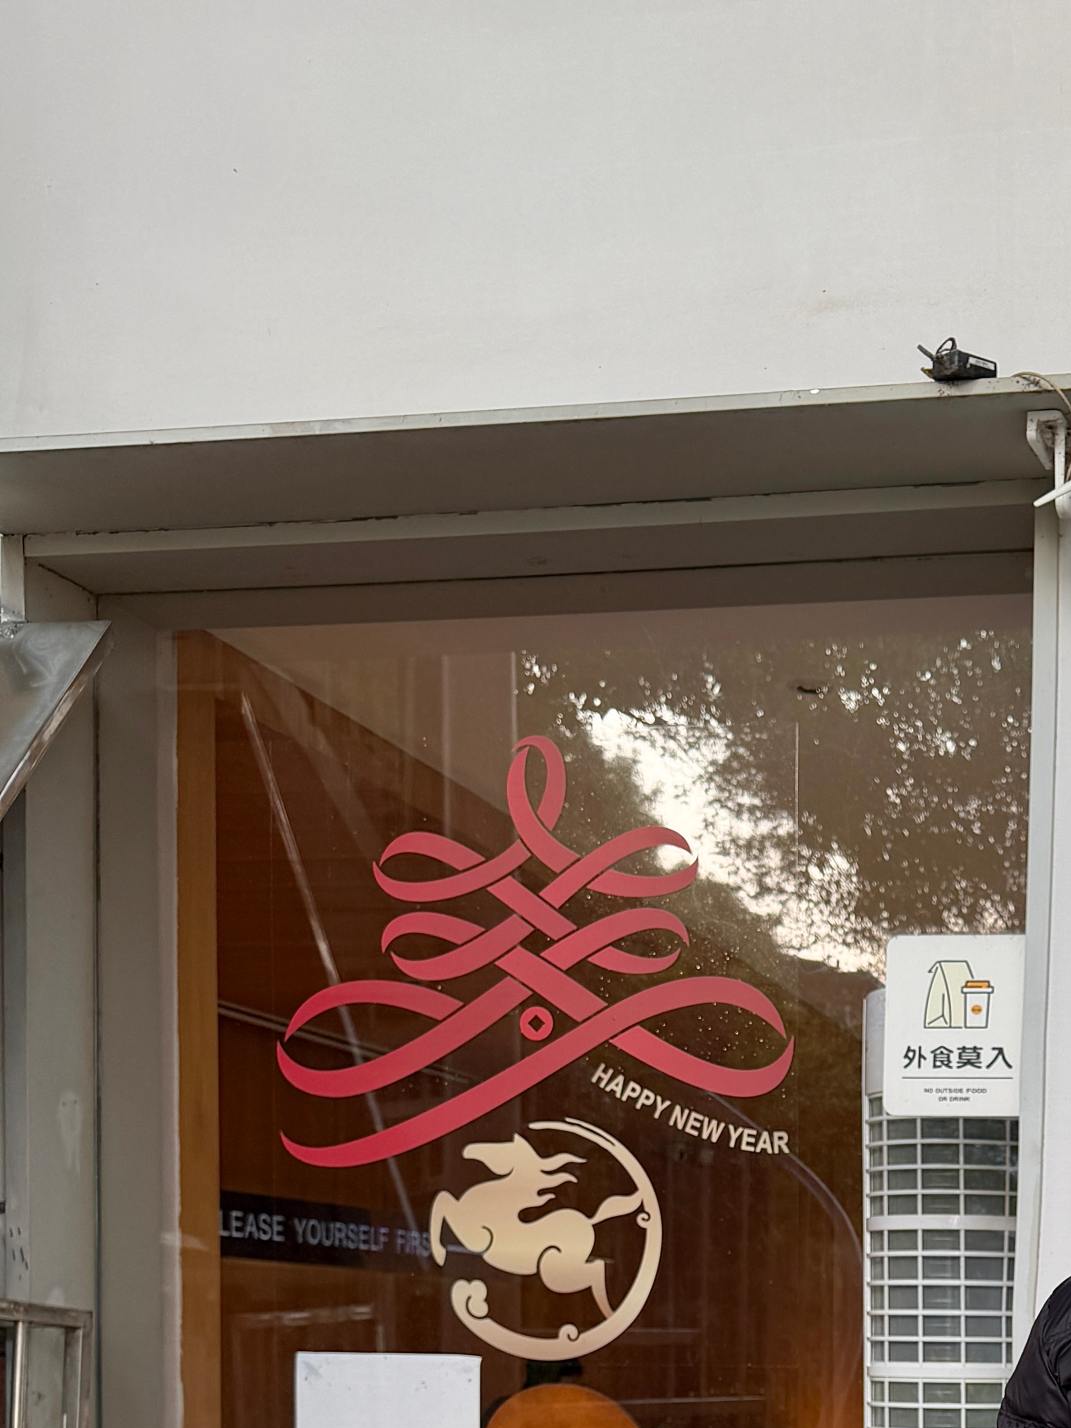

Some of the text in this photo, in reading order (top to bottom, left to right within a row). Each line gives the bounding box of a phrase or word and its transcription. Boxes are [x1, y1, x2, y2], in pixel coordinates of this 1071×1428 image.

[903, 1045, 1013, 1069] 外食莫入
[590, 1063, 790, 1155] HAPPY NEW YEAR
[218, 1209, 432, 1257] LEASE YOURSELF FIRS
